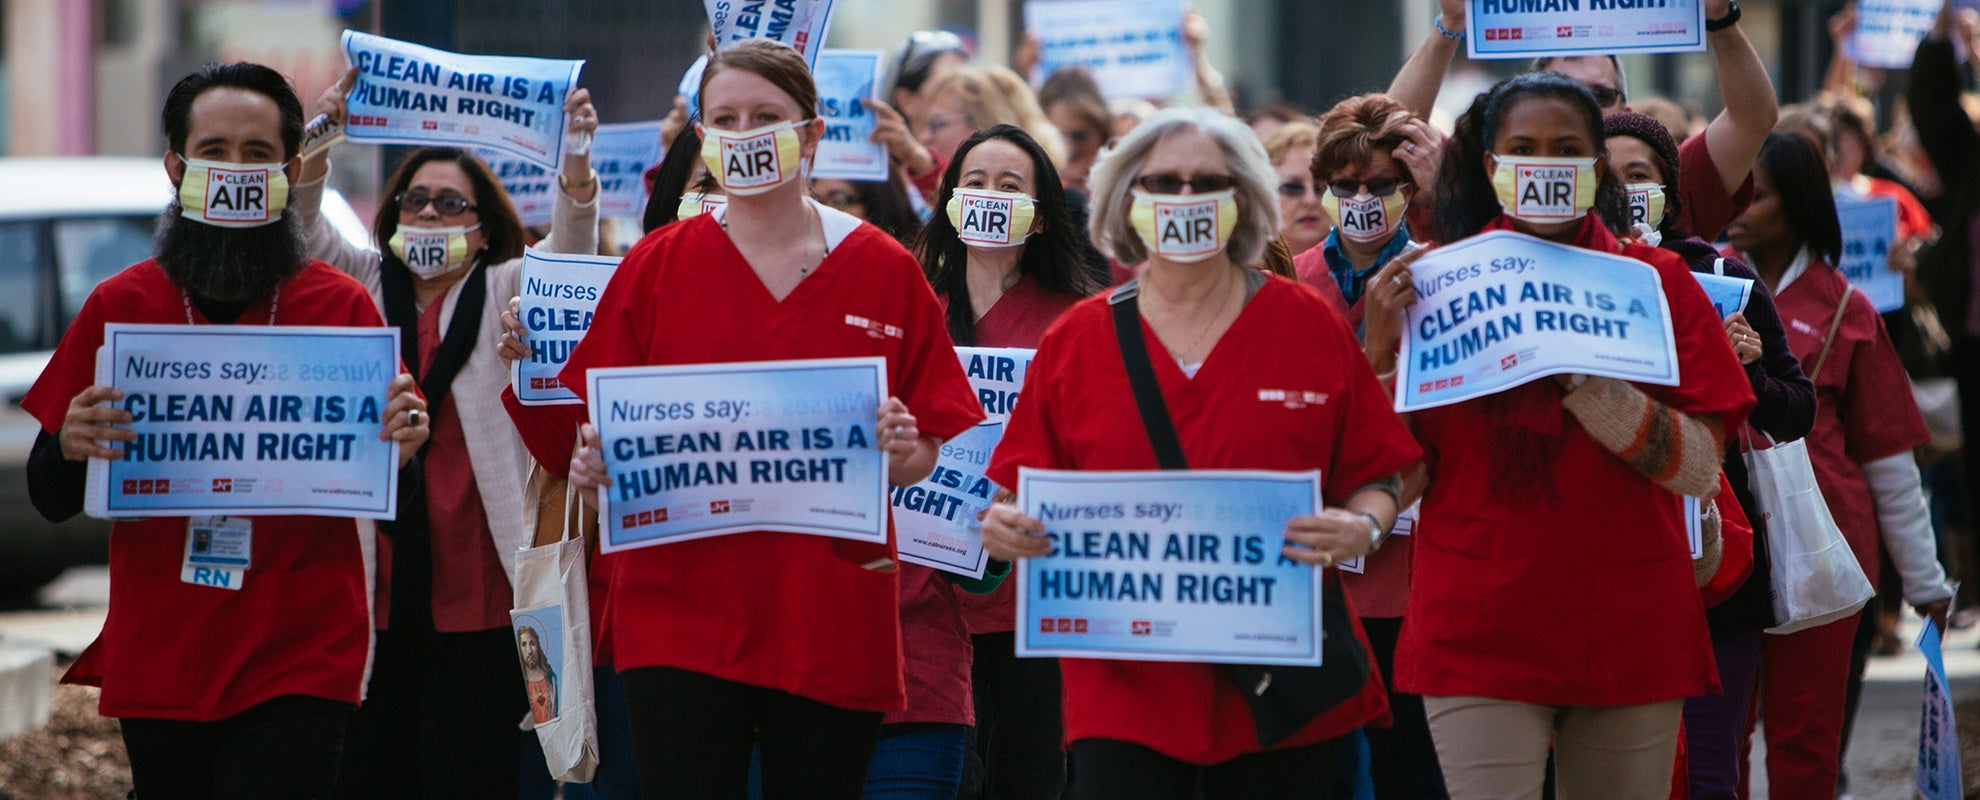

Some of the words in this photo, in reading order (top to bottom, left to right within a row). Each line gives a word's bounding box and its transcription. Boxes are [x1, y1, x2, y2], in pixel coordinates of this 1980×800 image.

[357, 51, 441, 86] CLEAN
[448, 72, 495, 94] AIR
[502, 75, 530, 100] IS
[537, 81, 555, 105] A
[355, 79, 448, 113] HUMAN
[457, 98, 535, 127] RIGHT
[849, 98, 864, 118] A
[734, 138, 772, 153] CLEAN
[727, 150, 775, 178] AIR
[1533, 169, 1574, 180] CLEAN
[225, 174, 264, 184] CLEAN
[210, 185, 264, 211] AIR
[975, 200, 1008, 211] CLEAN
[1351, 199, 1380, 212] CLEAN
[1520, 181, 1572, 206] AIR
[963, 209, 1007, 234] AIR
[1173, 205, 1213, 218] CLEAN
[1343, 210, 1382, 231] AIR
[1162, 218, 1212, 244] AIR
[407, 246, 445, 267] AIR
[1490, 256, 1537, 275] say:
[527, 277, 597, 301] Nurses
[1420, 283, 1507, 342] CLEAN
[1520, 281, 1574, 305] AIR
[1584, 290, 1617, 313] IS
[1628, 297, 1649, 319] A
[1420, 312, 1523, 372] HUMAN
[1535, 310, 1631, 340] RIGHT
[126, 357, 211, 379] Nurses
[220, 362, 268, 384] say:
[968, 354, 1015, 382] AIR
[124, 394, 234, 422] CLEAN
[245, 395, 302, 422] AIR
[314, 395, 346, 422] IS
[357, 396, 379, 423] A
[611, 401, 694, 422] Nurses
[704, 401, 750, 423] say:
[124, 433, 244, 462] HUMAN
[257, 434, 356, 461] RIGHT
[614, 432, 721, 461] CLEAN
[734, 429, 789, 451] AIR
[803, 428, 833, 449] IS
[847, 425, 867, 448] A
[618, 460, 737, 502] HUMAN
[750, 458, 847, 483] RIGHT
[931, 465, 963, 489] IS
[968, 478, 990, 499] A
[1039, 503, 1125, 521] Nurses
[1136, 502, 1184, 523] say:
[1163, 533, 1221, 563] AIR
[1233, 535, 1266, 564] IS
[194, 566, 231, 588] RN
[1039, 570, 1163, 602] HUMAN
[1177, 573, 1277, 606] RIGHT
